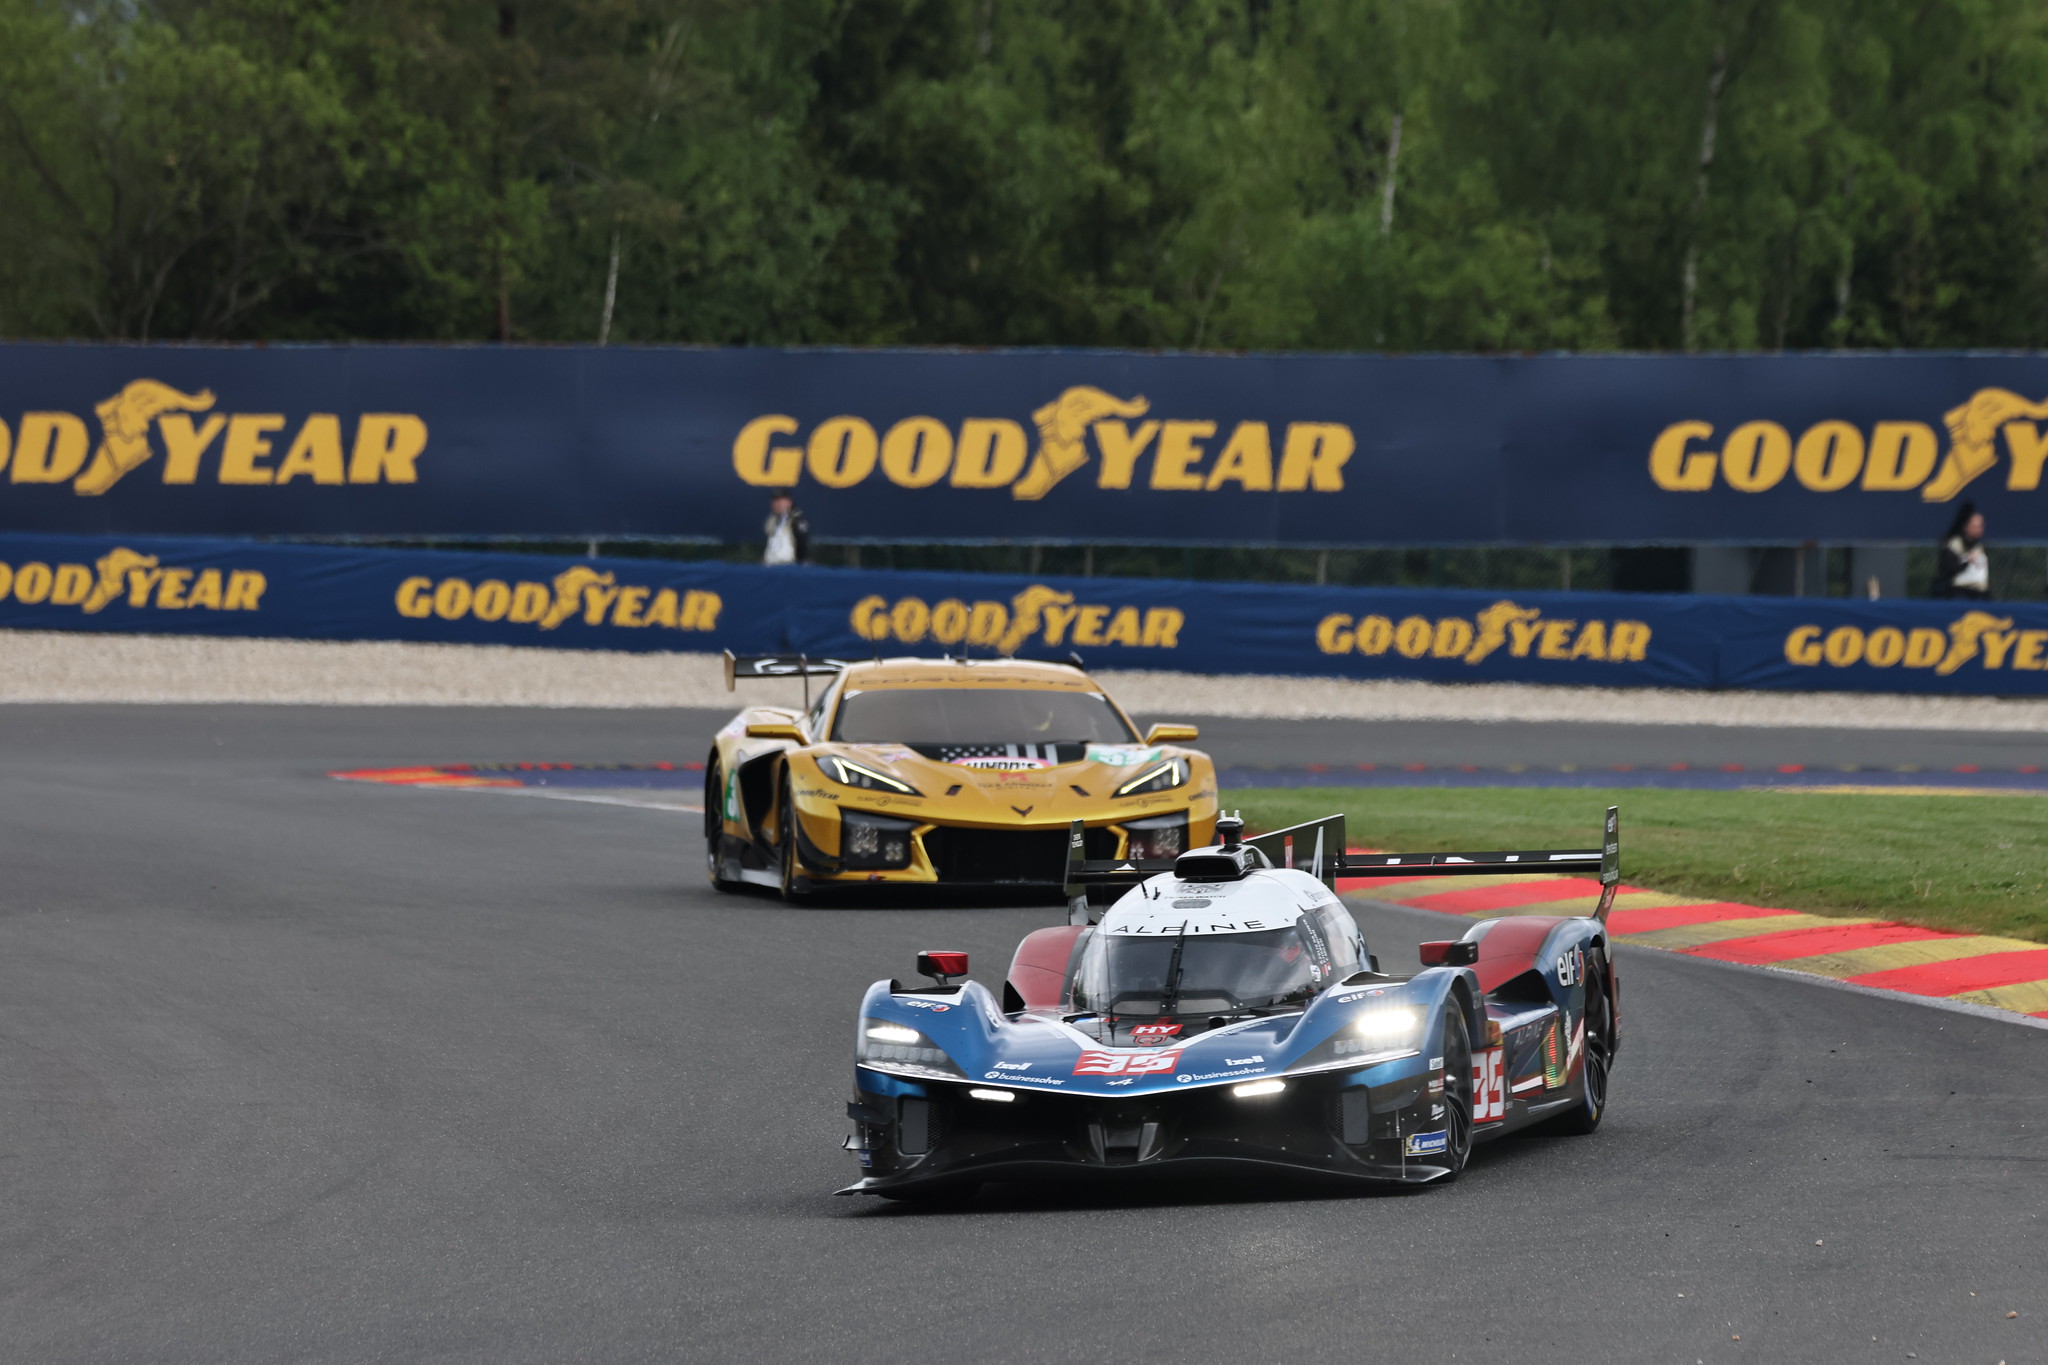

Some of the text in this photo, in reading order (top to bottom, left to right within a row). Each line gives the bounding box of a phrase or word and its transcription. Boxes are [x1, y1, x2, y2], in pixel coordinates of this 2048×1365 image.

[0, 412, 428, 485] DYEAR
[733, 414, 1355, 492] GOODYEAR
[395, 576, 722, 631] GOODYEAR
[850, 594, 1185, 649] GOODYEAR
[1316, 612, 1653, 663] GOODYEAR
[1784, 625, 2048, 670] GOODYE
[1112, 919, 1266, 934] ALPINE
[1557, 950, 1576, 987] elf
[1337, 992, 1366, 1004] elf
[1135, 1025, 1179, 1035] HY
[998, 1073, 1066, 1086] businessolver
[1077, 1050, 1180, 1074] 35
[1194, 1066, 1267, 1081] businessolver
[1471, 1050, 1505, 1120] 35
